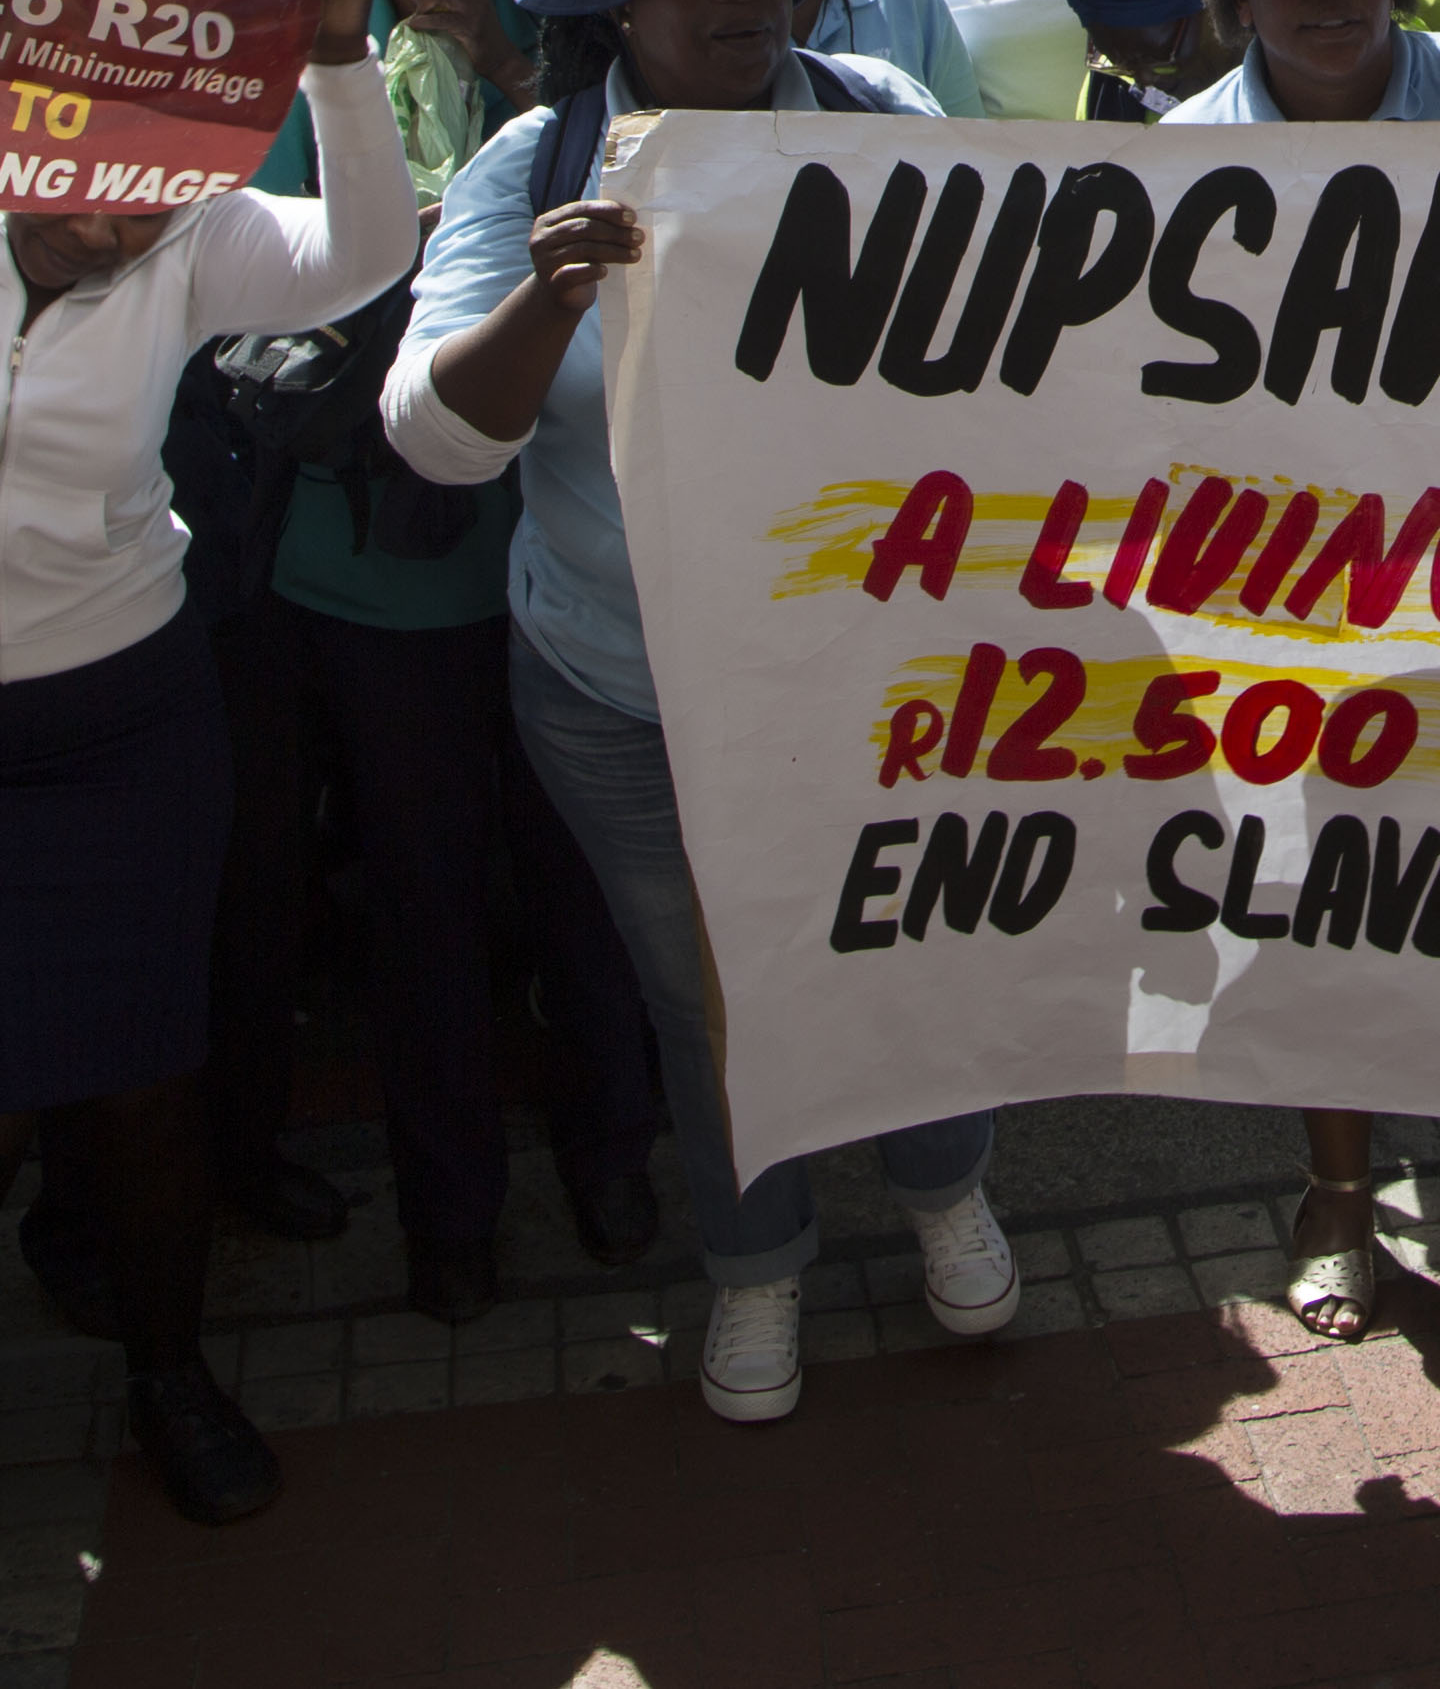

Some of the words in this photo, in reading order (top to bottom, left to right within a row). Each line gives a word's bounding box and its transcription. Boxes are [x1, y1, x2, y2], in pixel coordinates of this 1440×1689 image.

[8, 78, 92, 141] TO
[16, 38, 175, 91] Minimum
[178, 66, 265, 106] Wage
[861, 470, 975, 603] A
[877, 641, 1421, 790] R12.500
[829, 809, 1077, 953] END
